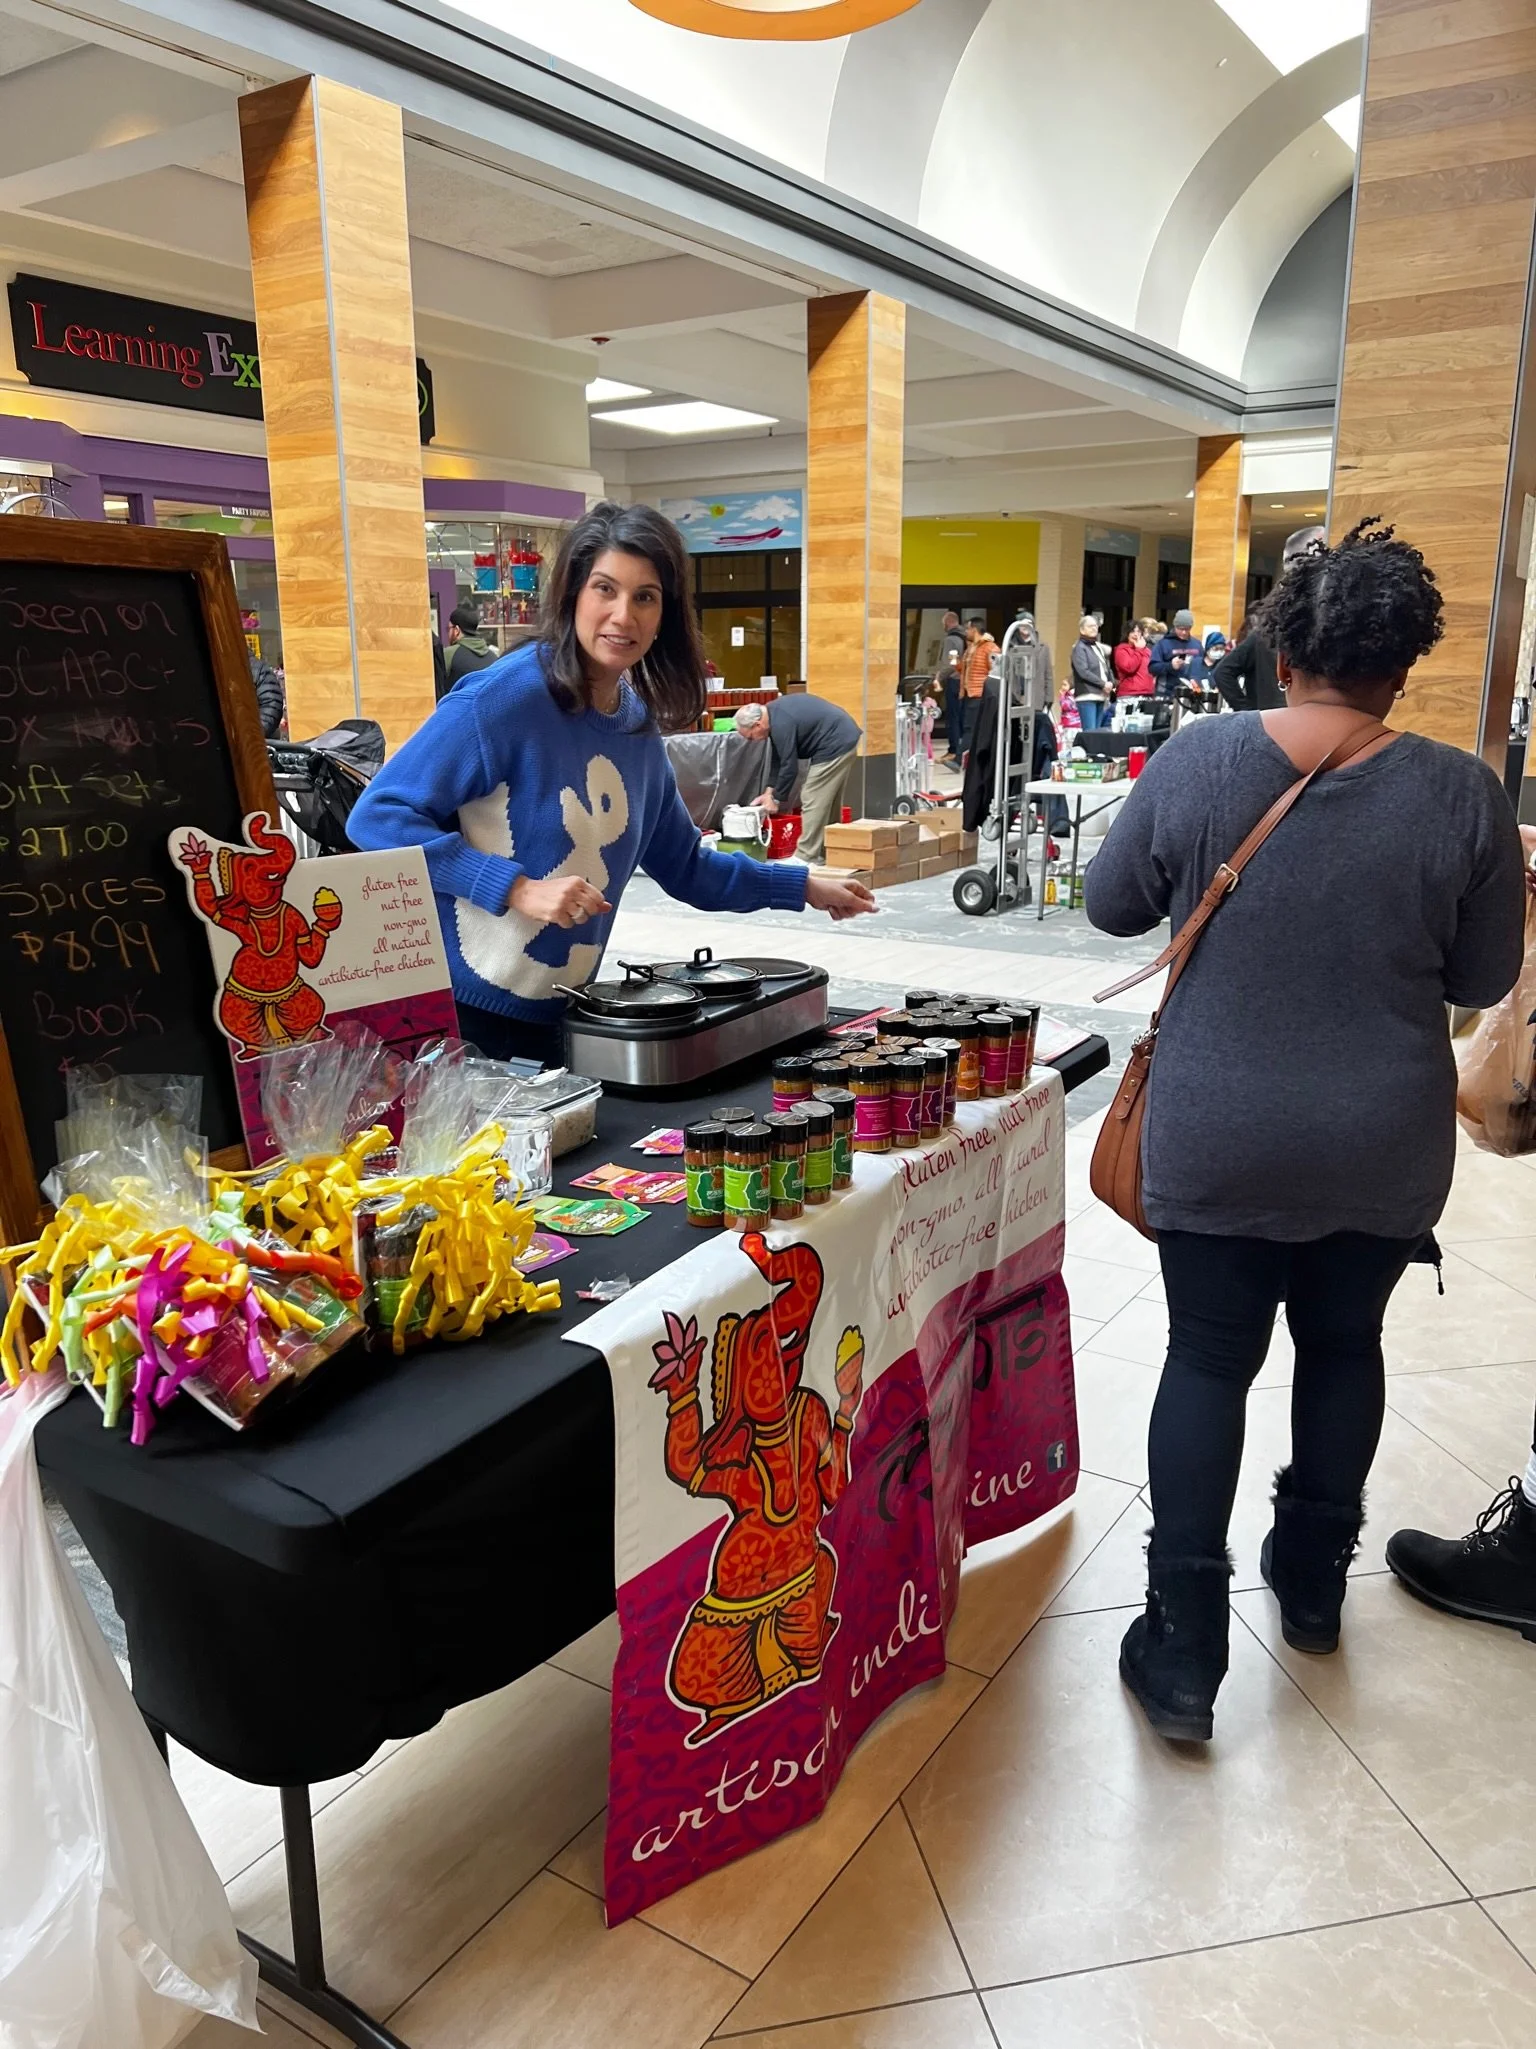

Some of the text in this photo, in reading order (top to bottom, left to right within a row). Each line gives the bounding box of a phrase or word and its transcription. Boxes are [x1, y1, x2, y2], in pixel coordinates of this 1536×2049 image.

[27, 300, 204, 389] Learning
[362, 872, 419, 901] gluten free
[381, 892, 424, 912] nut free
[383, 917, 427, 935] non-gmo
[373, 930, 432, 955] all natural
[318, 952, 436, 986] antibiotic-free chicken
[975, 1154, 1003, 1200] all
[1000, 1177, 1050, 1230] hicken
